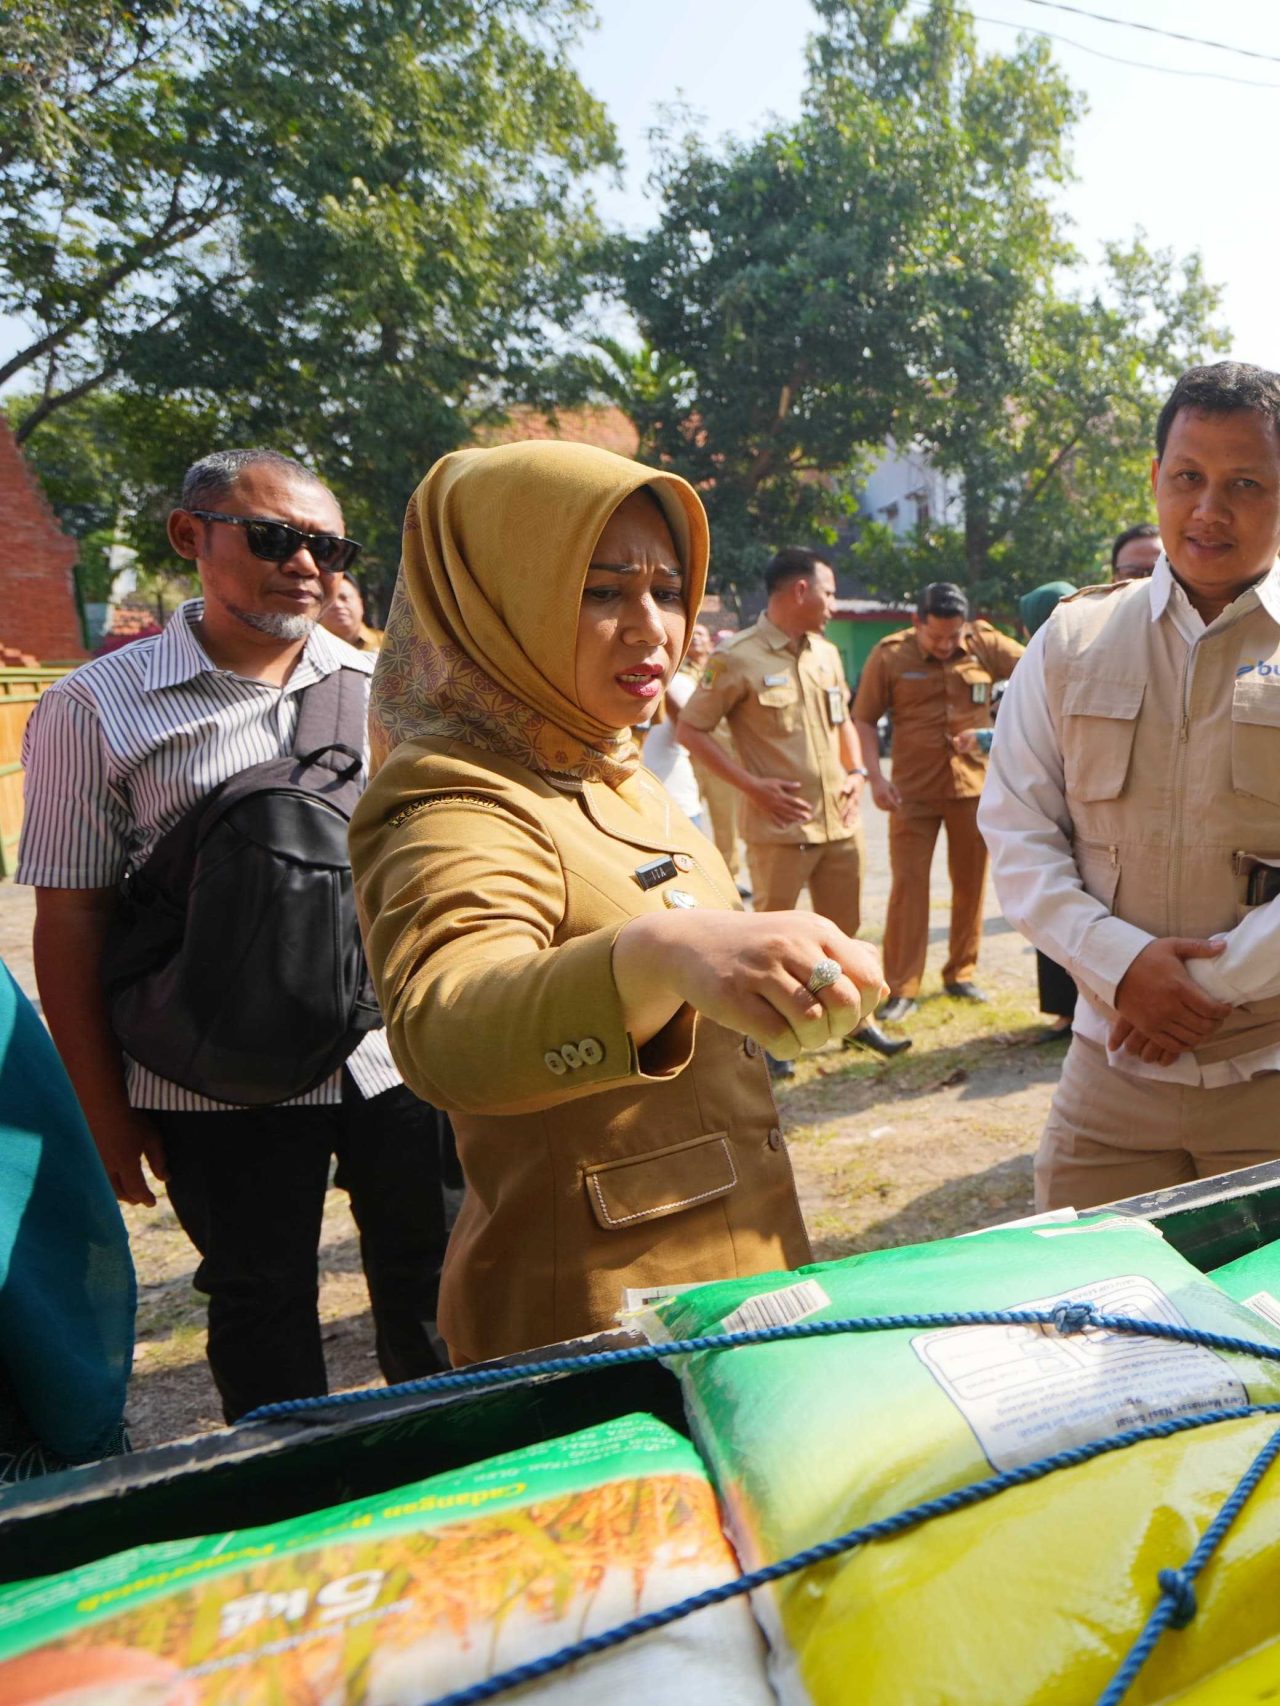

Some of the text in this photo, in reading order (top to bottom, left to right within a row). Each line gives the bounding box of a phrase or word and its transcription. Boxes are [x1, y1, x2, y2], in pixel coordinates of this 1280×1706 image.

[650, 866, 667, 881] ITA
[218, 1568, 385, 1639] 5 kg
